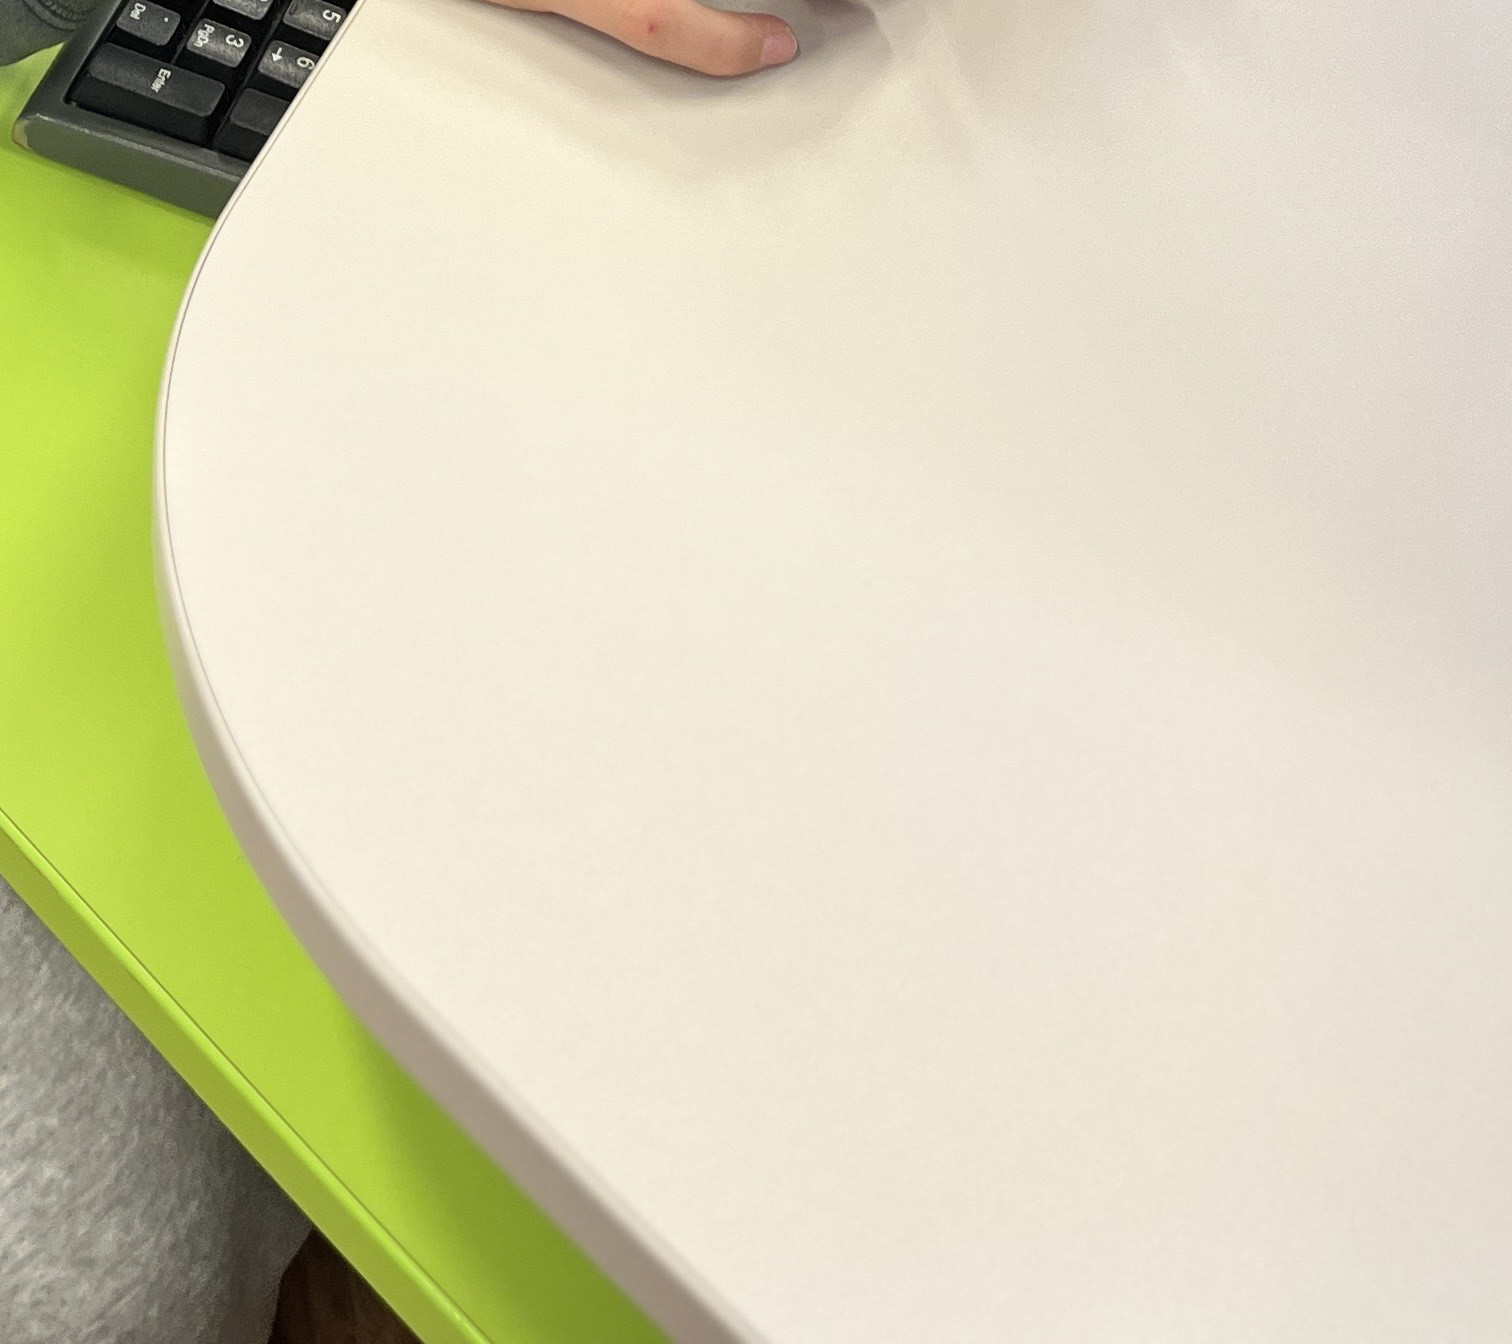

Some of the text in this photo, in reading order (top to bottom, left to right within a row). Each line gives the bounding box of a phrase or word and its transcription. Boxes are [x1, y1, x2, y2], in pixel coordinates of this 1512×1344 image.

[322, 9, 341, 23] 5
[194, 23, 214, 48] PgDn
[226, 34, 244, 48] 3
[297, 56, 315, 70] 6
